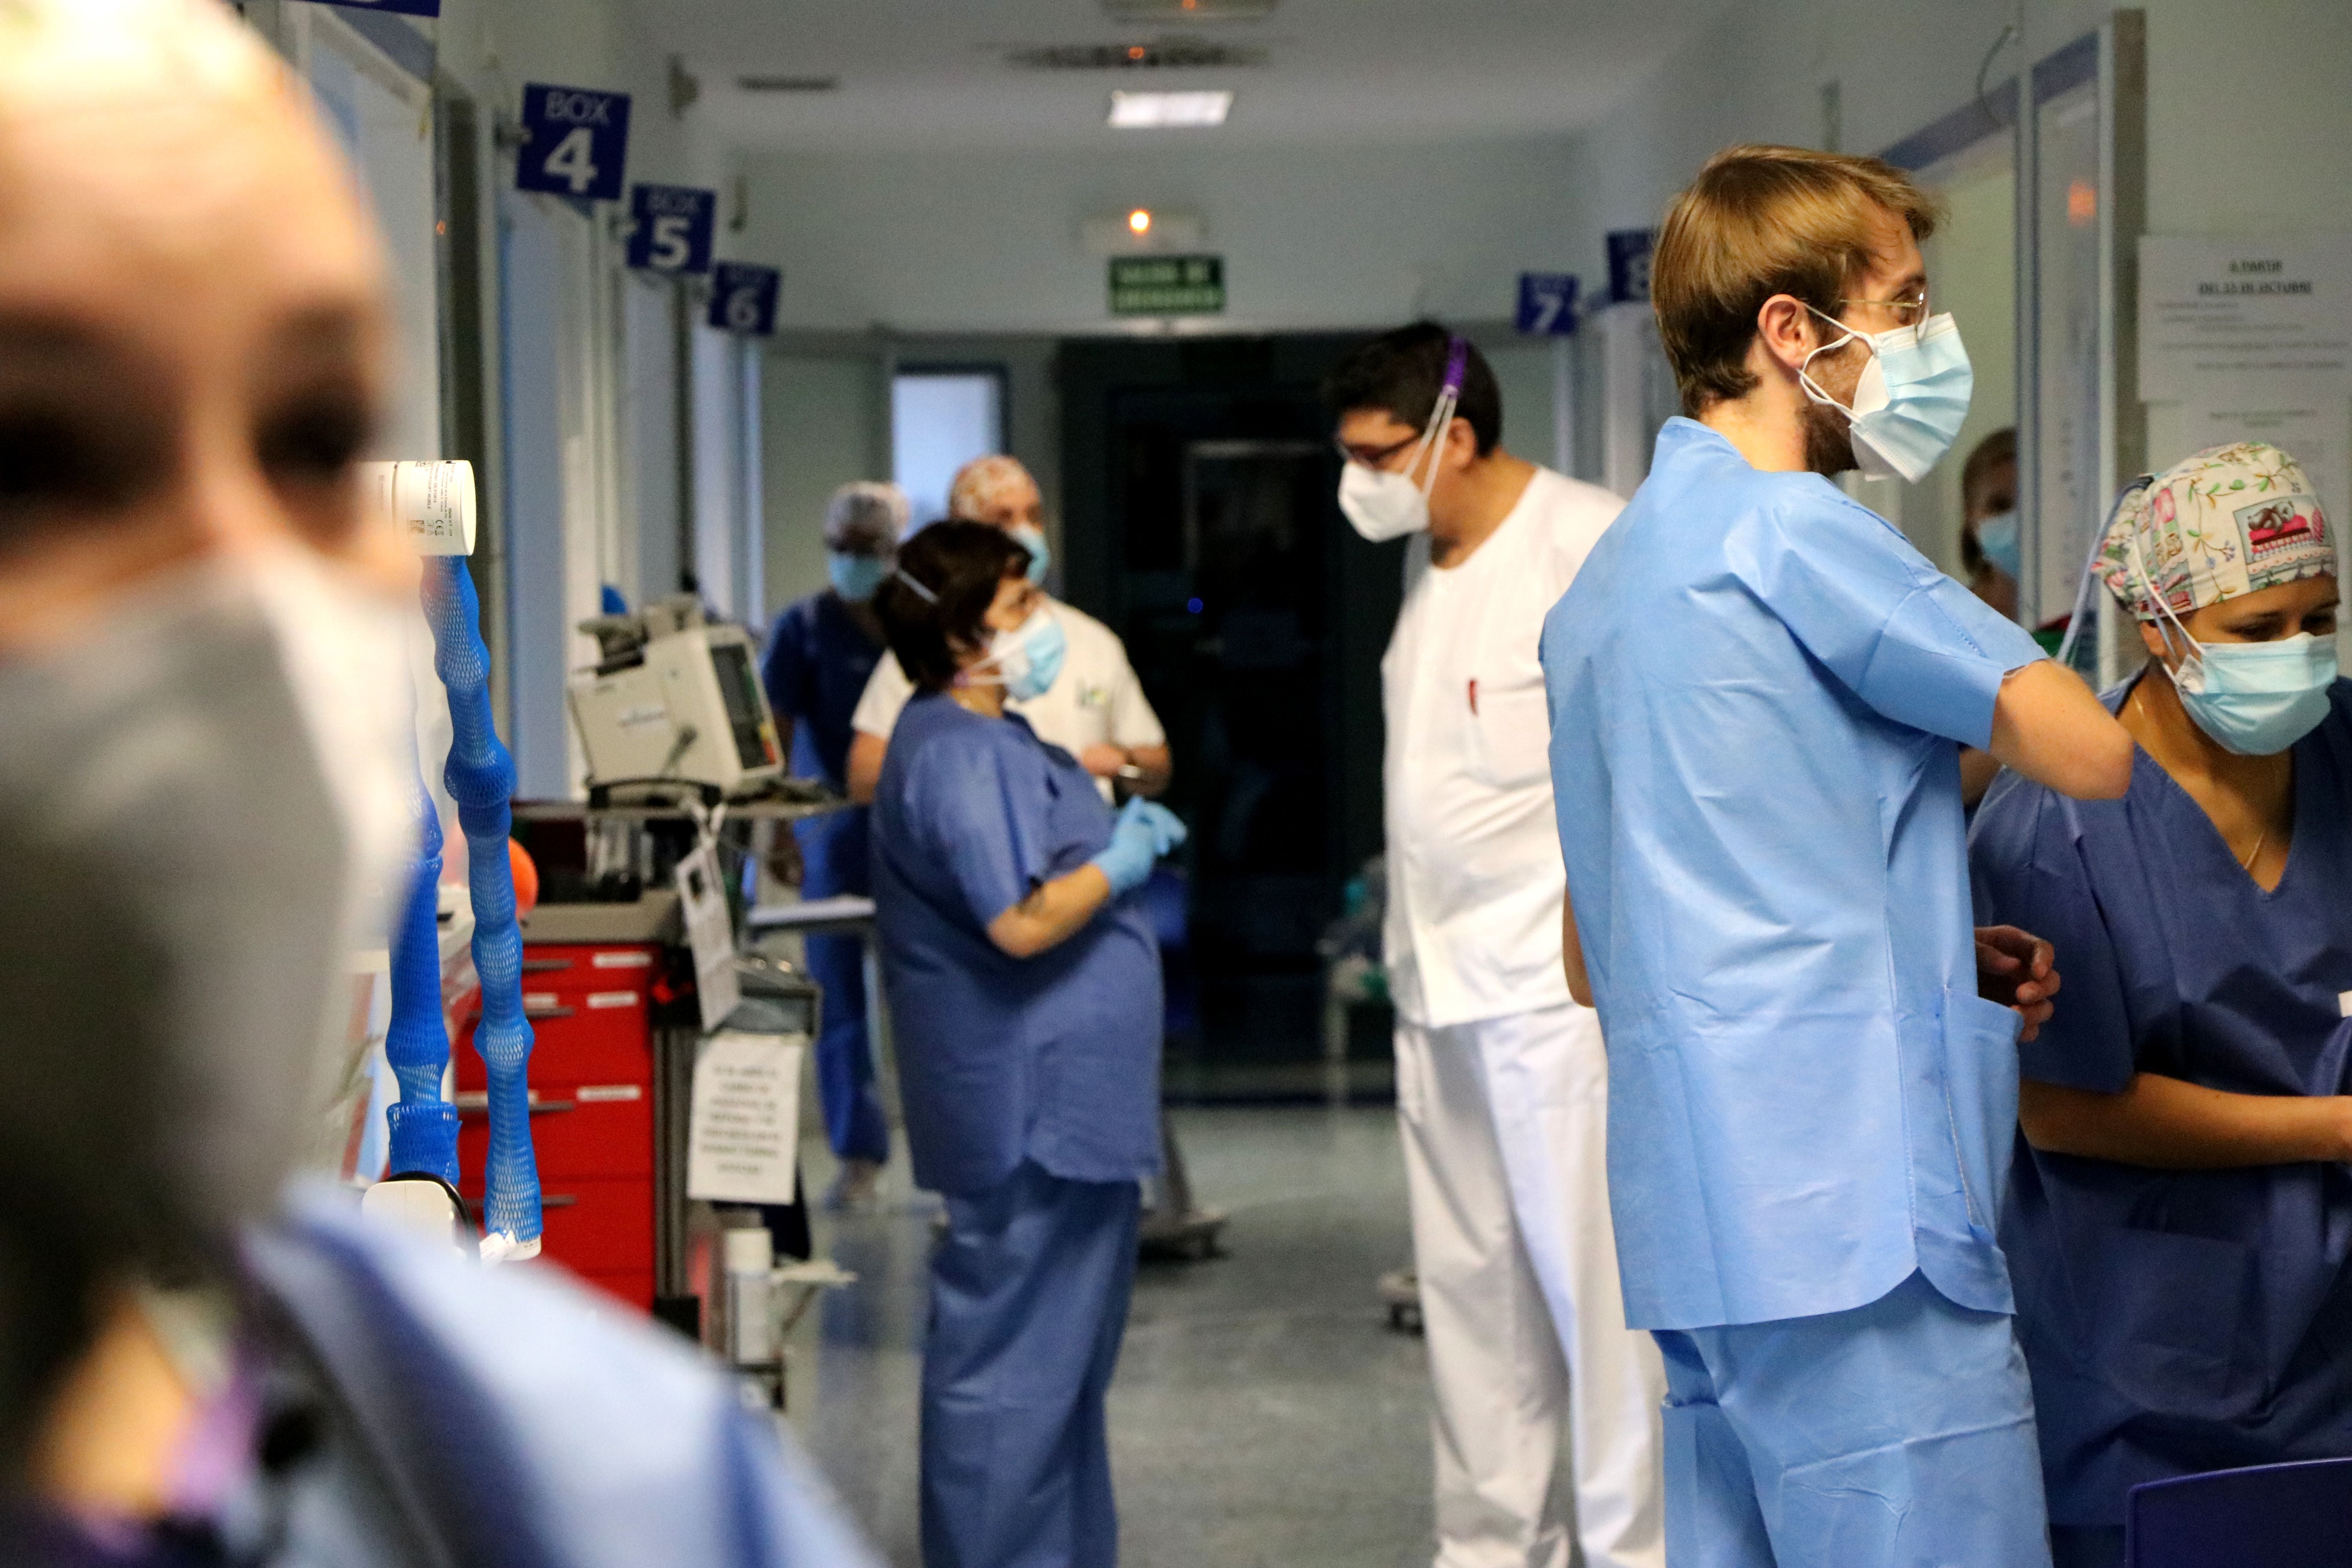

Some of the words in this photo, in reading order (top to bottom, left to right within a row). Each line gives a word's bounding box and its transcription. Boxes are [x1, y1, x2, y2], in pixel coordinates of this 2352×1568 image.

[544, 92, 610, 126] BOX
[543, 126, 599, 192] 4
[648, 217, 690, 267] 5
[727, 288, 758, 327] 6
[1530, 293, 1564, 331] 7
